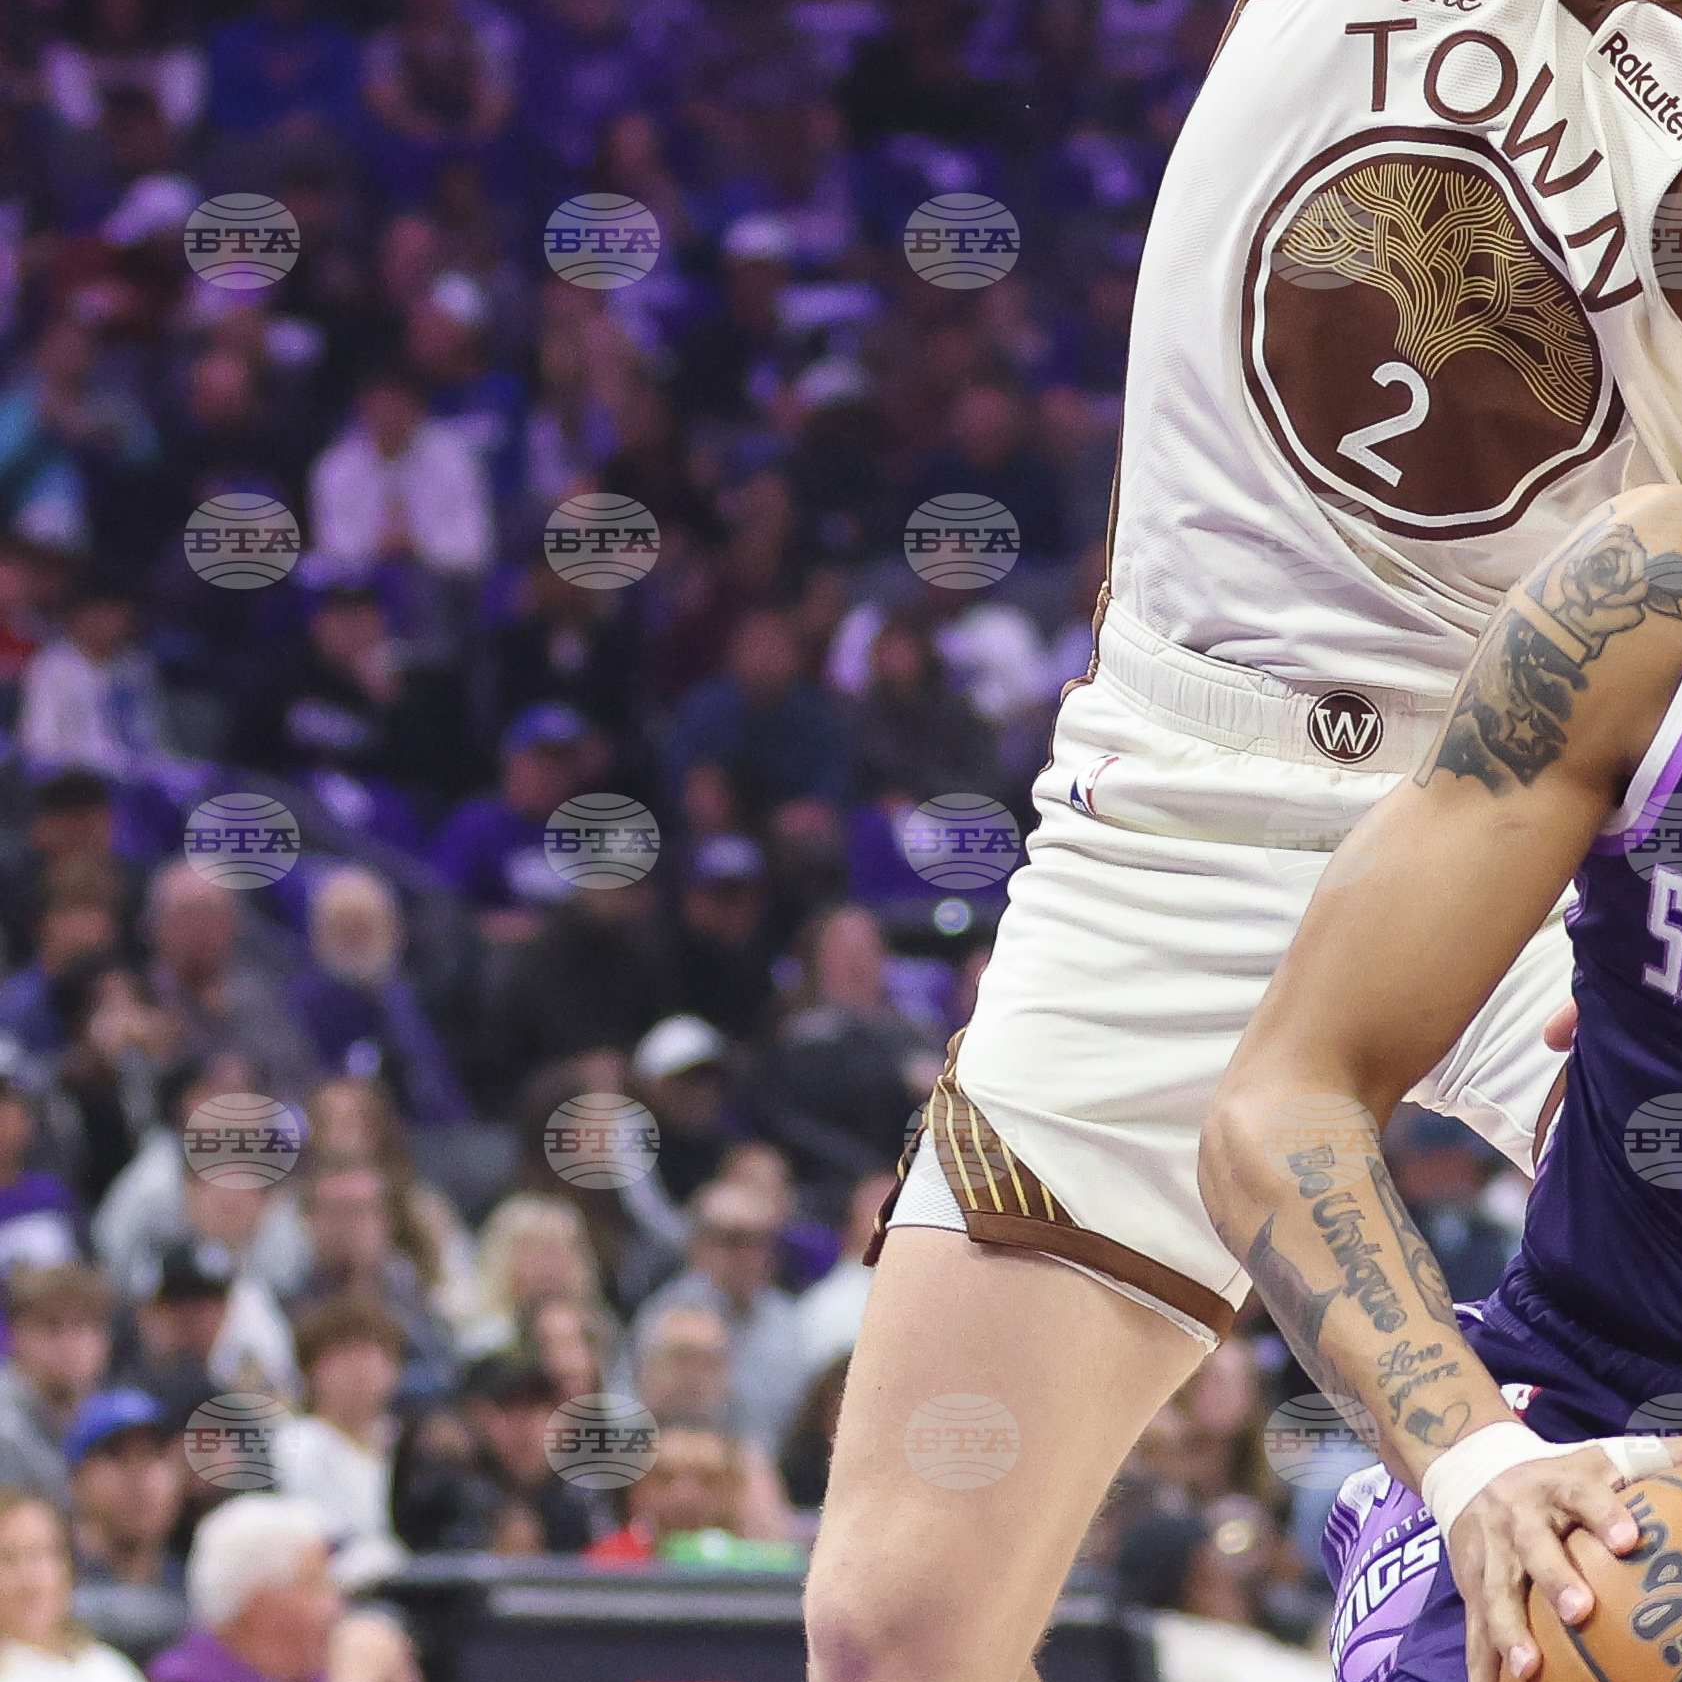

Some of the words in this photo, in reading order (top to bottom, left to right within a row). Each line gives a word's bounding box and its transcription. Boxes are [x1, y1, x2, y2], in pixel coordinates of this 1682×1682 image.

[1346, 18, 1643, 312] TOWN
[1336, 360, 1432, 488] 2
[1313, 707, 1378, 755] W
